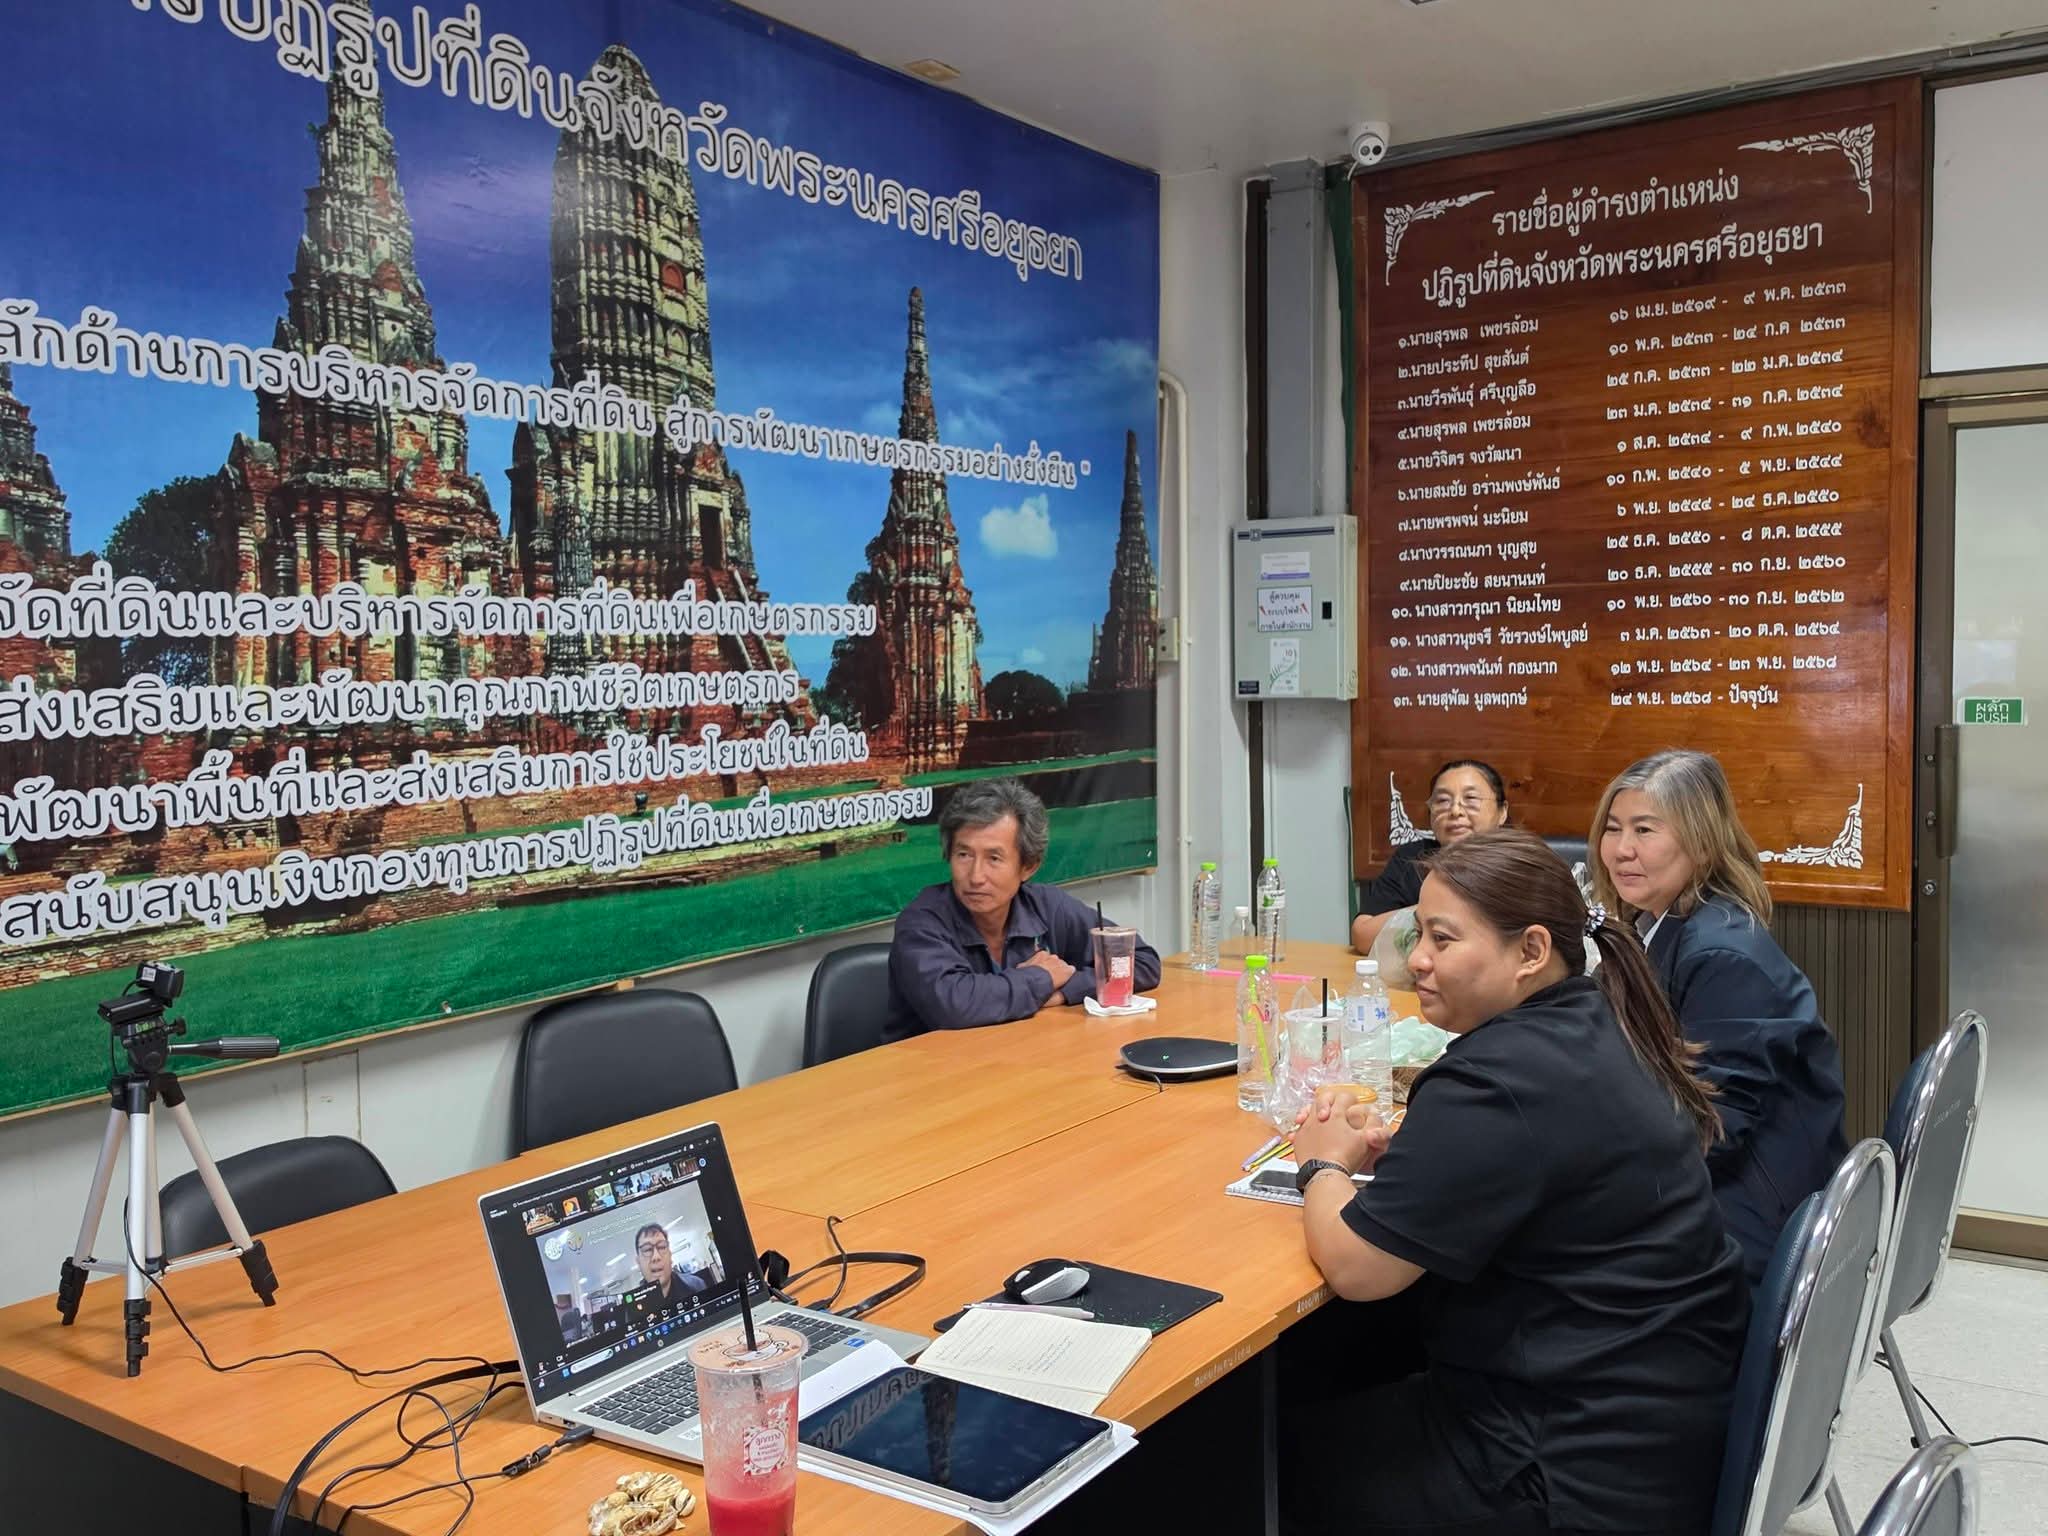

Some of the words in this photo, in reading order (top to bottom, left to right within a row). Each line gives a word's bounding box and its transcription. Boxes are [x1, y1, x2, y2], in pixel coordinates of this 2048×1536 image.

[1492, 168, 1741, 238] รายชื่อผู้ดำรงตำแหน่ง
[1422, 222, 1823, 308] ปฏิรูปที่ดินจังหวัดพระนครศรีอยุธยา
[1398, 327, 1469, 349] ๑.นายสุรพล
[1480, 314, 1539, 338] เพชรล้อม
[1609, 308, 1629, 323] ๑๖
[1635, 302, 1669, 319] เม.ย.
[1671, 295, 1717, 314] ๒๕๑๙
[1743, 290, 1756, 305] ๙
[1763, 286, 1795, 302] พ.ค.
[1801, 281, 1847, 298] ๒๕๓๓
[1608, 343, 1629, 357] ๑๐
[1634, 336, 1665, 352] พ.ค.
[1671, 332, 1714, 348] ๒๕๓๓
[1733, 324, 1758, 341] ๒๔
[1800, 316, 1846, 333] ๒๕๓๓
[1606, 372, 1630, 388] ๒๕
[1633, 369, 1661, 385] ก.ค.
[1668, 365, 1711, 381] ๒๕๓๓
[1731, 359, 1757, 374] ๒๒
[1762, 354, 1794, 371] ม.ค.
[1796, 348, 1844, 367] ๒๕๓๔
[1397, 421, 1468, 442] ๔.นายสุรพล
[1472, 409, 1531, 433] เพชรล้อม
[1606, 407, 1628, 420] ๒๓
[1632, 402, 1662, 418] ม.ค.
[1668, 396, 1712, 414] ๒๕๓๔
[1731, 395, 1753, 409] ๓๑
[1762, 388, 1793, 405] ก.ค.
[1796, 383, 1844, 402] ๒๕๓๔
[663, 393, 1078, 489] สู่การพัฒนาเกษตรกรรมอย่างยั่งยืน
[1397, 449, 1465, 471] ๕.นายวิจิตร
[1469, 444, 1522, 464] จงวัฒนา
[1616, 440, 1627, 453] ๑
[1633, 435, 1661, 451] ส.ค.
[1668, 430, 1712, 448] ๒๕๓๔
[1740, 426, 1753, 441] ๙
[1762, 423, 1793, 439] ก.พ.
[1795, 419, 1842, 436] ๒๕๔๐
[1397, 479, 1467, 502] ๖.นายสมชัย
[1606, 473, 1626, 487] ๑๐
[1632, 468, 1661, 483] ก.พ.
[1667, 464, 1712, 481] ๒๕๔๐
[1739, 460, 1751, 475] ๕
[1759, 457, 1791, 473] พ.ย.
[1795, 453, 1843, 471] ๒๕๔๔
[1482, 506, 1529, 526] มะนิยม
[1616, 503, 1627, 517] ๖
[1632, 501, 1661, 516] พ.ย.
[1668, 496, 1712, 514] ๒๕๔๔
[1731, 493, 1756, 509] ๒๔
[1762, 491, 1792, 507] ธ.ค.
[1793, 488, 1840, 505] ๒๕๕๐
[1398, 543, 1492, 562] ๘.นางวรรณนภา
[1496, 540, 1537, 561] บุญสุข
[1606, 535, 1629, 549] ๒๕
[1633, 533, 1661, 548] ธ.ค.
[1668, 530, 1711, 546] ๒๕๕๐
[1741, 527, 1753, 542] ๘
[1761, 525, 1791, 540] ต.ค.
[1795, 521, 1843, 539] ๒๕๕๕
[1399, 571, 1479, 592] ๙.นายปิยะชัย
[1607, 568, 1629, 582] ๒๐
[1634, 565, 1662, 580] ธ.ค.
[1668, 561, 1713, 578] ๒๕๕๕
[1731, 561, 1754, 573] ๓๐
[1760, 556, 1792, 572] ก.ย.
[1798, 554, 1847, 570] ๒๕๖๐
[1391, 607, 1413, 620] ๑๐.
[1414, 601, 1501, 621] นางสาวกรุณา
[1505, 592, 1562, 614] นิยมไทย
[1606, 598, 1626, 612] ๑๐
[1634, 594, 1663, 609] พ.ย.
[1669, 592, 1712, 608] ๒๕๖๐
[1728, 594, 1750, 606] ๓๐
[1756, 590, 1788, 605] ก.ย.
[1794, 588, 1845, 604] ๒๕๖๒
[1389, 636, 1411, 649] ๑๑.
[1415, 626, 1492, 651] นางสาวนุชจรี
[1620, 631, 1630, 642] ๓
[1634, 626, 1663, 641] ม.ค.
[1666, 625, 1711, 640] ๒๕๖๓
[1728, 624, 1752, 639] ๒๐
[1757, 622, 1789, 637] ต.ค.
[1794, 620, 1841, 637] ๒๕๖๔
[1390, 664, 1412, 679] ๑๒.
[1415, 655, 1503, 677] นางสาวพจนันท์
[1508, 660, 1558, 675] กองมาก
[1610, 660, 1632, 676] ๑๒
[1636, 659, 1665, 674] พ.ย.
[1670, 658, 1712, 673] ๒๕๖๔
[1728, 657, 1751, 671] ๒๓
[1756, 655, 1787, 670] พ.ย.
[1792, 655, 1839, 670] ๒๕๖๘
[0, 662, 799, 742] ส่งเสริมและพัฒนาคุณภาพชีวิตเกษตรกร
[1393, 696, 1413, 708] ๑๓.
[1473, 686, 1528, 712] มูลพฤกษ์
[1610, 692, 1633, 706] ๒๔
[1636, 691, 1665, 705] พ.ย.
[1670, 690, 1712, 705] ๒๕๖๘
[1728, 682, 1779, 710] ปัจจุบัน
[1976, 697, 2009, 712] ผลัก
[1976, 712, 2009, 723] PUSH
[0, 715, 869, 842] พัฒนาพื้นที่และส่งเสริมการใช้ประโยชน์ในที่ดิน
[1, 787, 933, 944] สนับสนุนเงินกองทุนการปฏิรูปที่ดินเพื่อเกษตรกรรม
